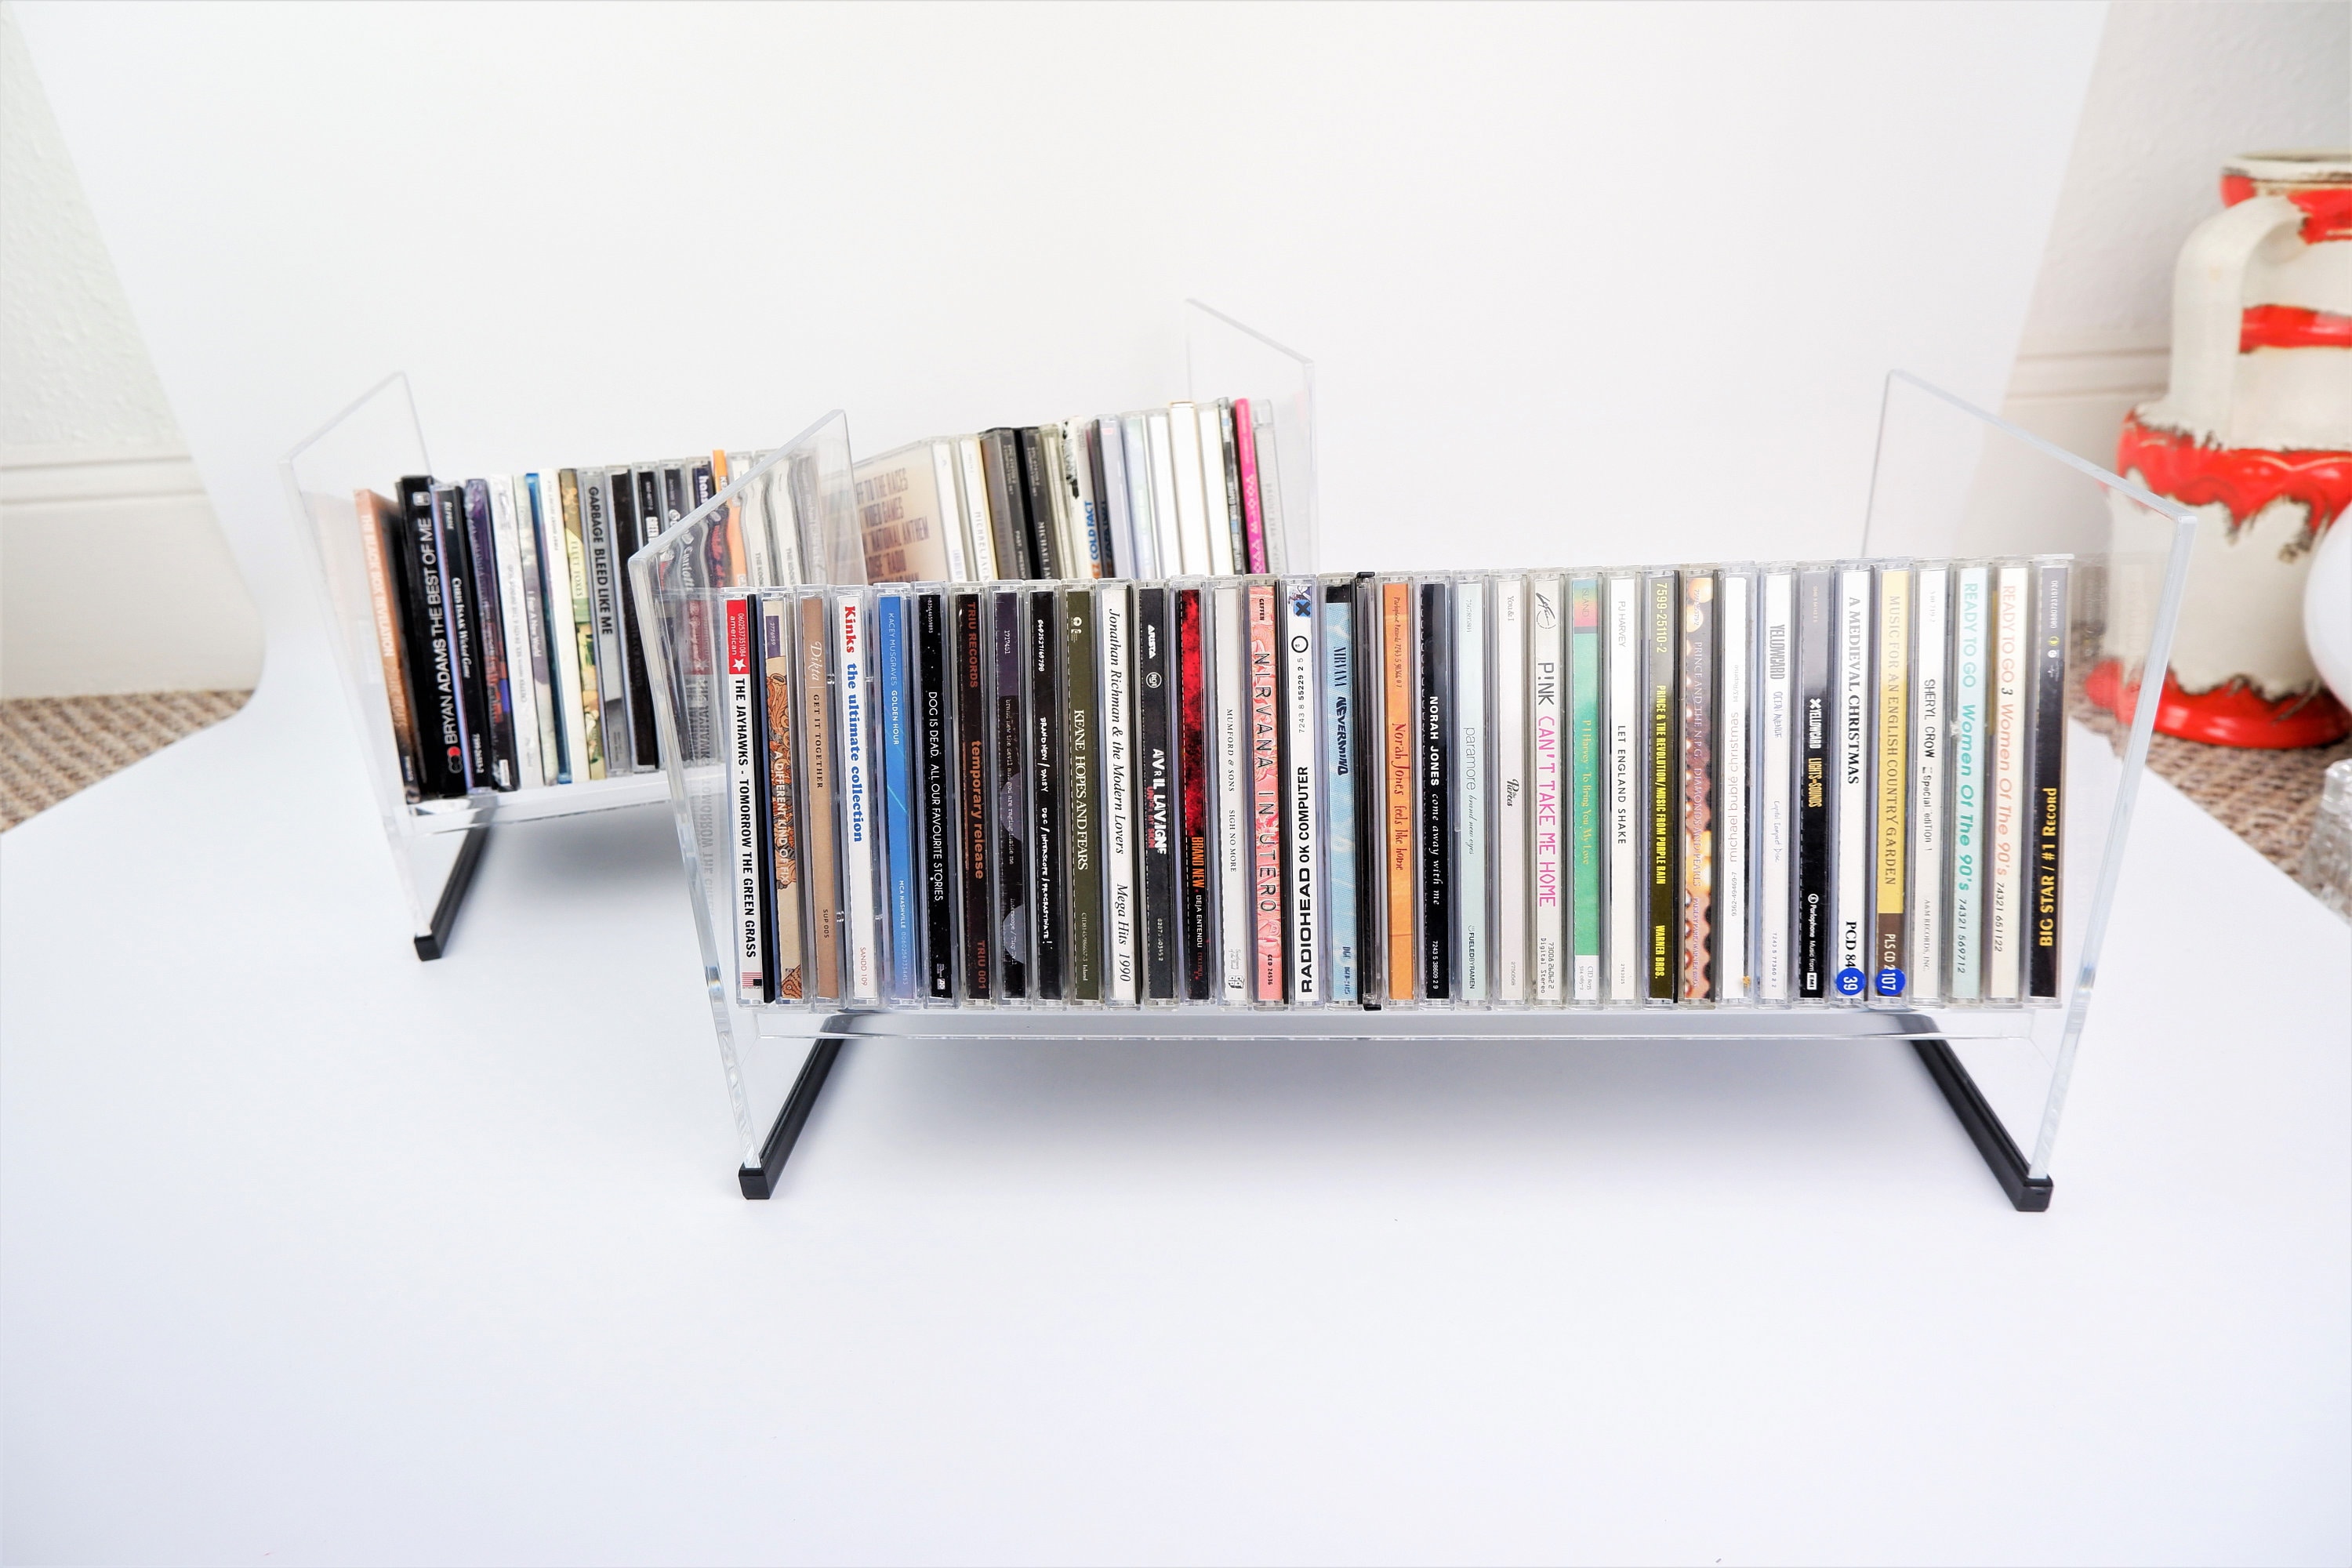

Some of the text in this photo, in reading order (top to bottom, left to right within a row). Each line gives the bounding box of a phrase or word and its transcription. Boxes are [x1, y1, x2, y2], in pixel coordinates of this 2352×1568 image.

[1084, 501, 1098, 560] COLD FACT
[589, 487, 612, 634] GARBAGE BLEED LIKE ME
[418, 519, 458, 744] BRYAN ADAMS THE BEST OF ME
[730, 616, 739, 655] american
[738, 613, 746, 657] 0602537351084
[1657, 583, 1668, 653] 7599-25110-2
[808, 641, 822, 681] Dikta
[967, 602, 978, 688] TRIU RECORDS
[1148, 625, 1156, 659] ARISTA
[1769, 625, 1785, 679] YELLOWCARD
[735, 678, 746, 701] THE
[928, 692, 938, 716] DOG
[1657, 685, 1666, 713] PRINCE
[1847, 597, 1860, 784] A MEDIEVAL CHRISTMAS
[815, 719, 821, 728] IT
[845, 606, 863, 842] Kinks the ultimate collection
[1109, 608, 1125, 854] Jonathan Richman & the Modern Lovers
[1334, 647, 1348, 776] NIRVANA NEVERMIND
[1656, 723, 1667, 736] THE
[1809, 708, 1821, 749] YELLOWCARD
[1925, 679, 1936, 757] SHERYL CROW
[736, 705, 748, 766] JAYHAWKS
[930, 730, 939, 757] DEAD.
[1885, 596, 1900, 885] MUSIC FOR AN ENGLISH COUNTRY GARDEN
[1958, 583, 1978, 891] READY TO GO Women Of The 90's
[931, 764, 940, 780] ALL
[1430, 746, 1439, 786] JONES
[1464, 728, 1477, 790] paramore
[1617, 750, 1626, 803] ENGLAND
[775, 763, 786, 816] DIFFERENT
[931, 783, 940, 805] OUR
[1074, 710, 1088, 870] KEANE HOPES AND FEARS
[1152, 749, 1167, 855] AVRIL LAVIGNE
[1254, 652, 1276, 912] NIRVANA IN UTERO
[1538, 662, 1555, 907] P!NK CAN'T TAKE ME HOME
[1728, 713, 1739, 862] michael bublé christmas
[739, 779, 751, 848] TOMORROW
[970, 741, 985, 879] temporary release
[1656, 814, 1666, 835] FROM
[779, 819, 787, 845] KIND
[932, 808, 942, 859] FAVOURITE
[1192, 837, 1203, 866] BRAND
[1229, 833, 1236, 846] NO
[1428, 826, 1441, 855] away
[1656, 837, 1666, 864] PURPLE
[2043, 844, 2055, 860] #1
[742, 852, 752, 874] THE
[779, 850, 788, 862] OF
[779, 867, 789, 883] FIX
[1432, 860, 1443, 884] with
[1656, 866, 1666, 884] RAIN
[743, 878, 754, 916] GREEN
[934, 862, 943, 901] STORIES
[1192, 869, 1204, 887] NEW
[1298, 767, 1312, 993] RADIOHEAD OK COMPUTER
[1433, 891, 1440, 905] me
[2040, 876, 2054, 913] STAR
[745, 920, 756, 957] GRASS
[1115, 884, 1131, 982] Mega Hits 1990
[1655, 925, 1665, 978] WARNER BROS.
[2039, 919, 2053, 946] BIG
[1843, 976, 1857, 990] 39
[1882, 973, 1896, 990] 107
